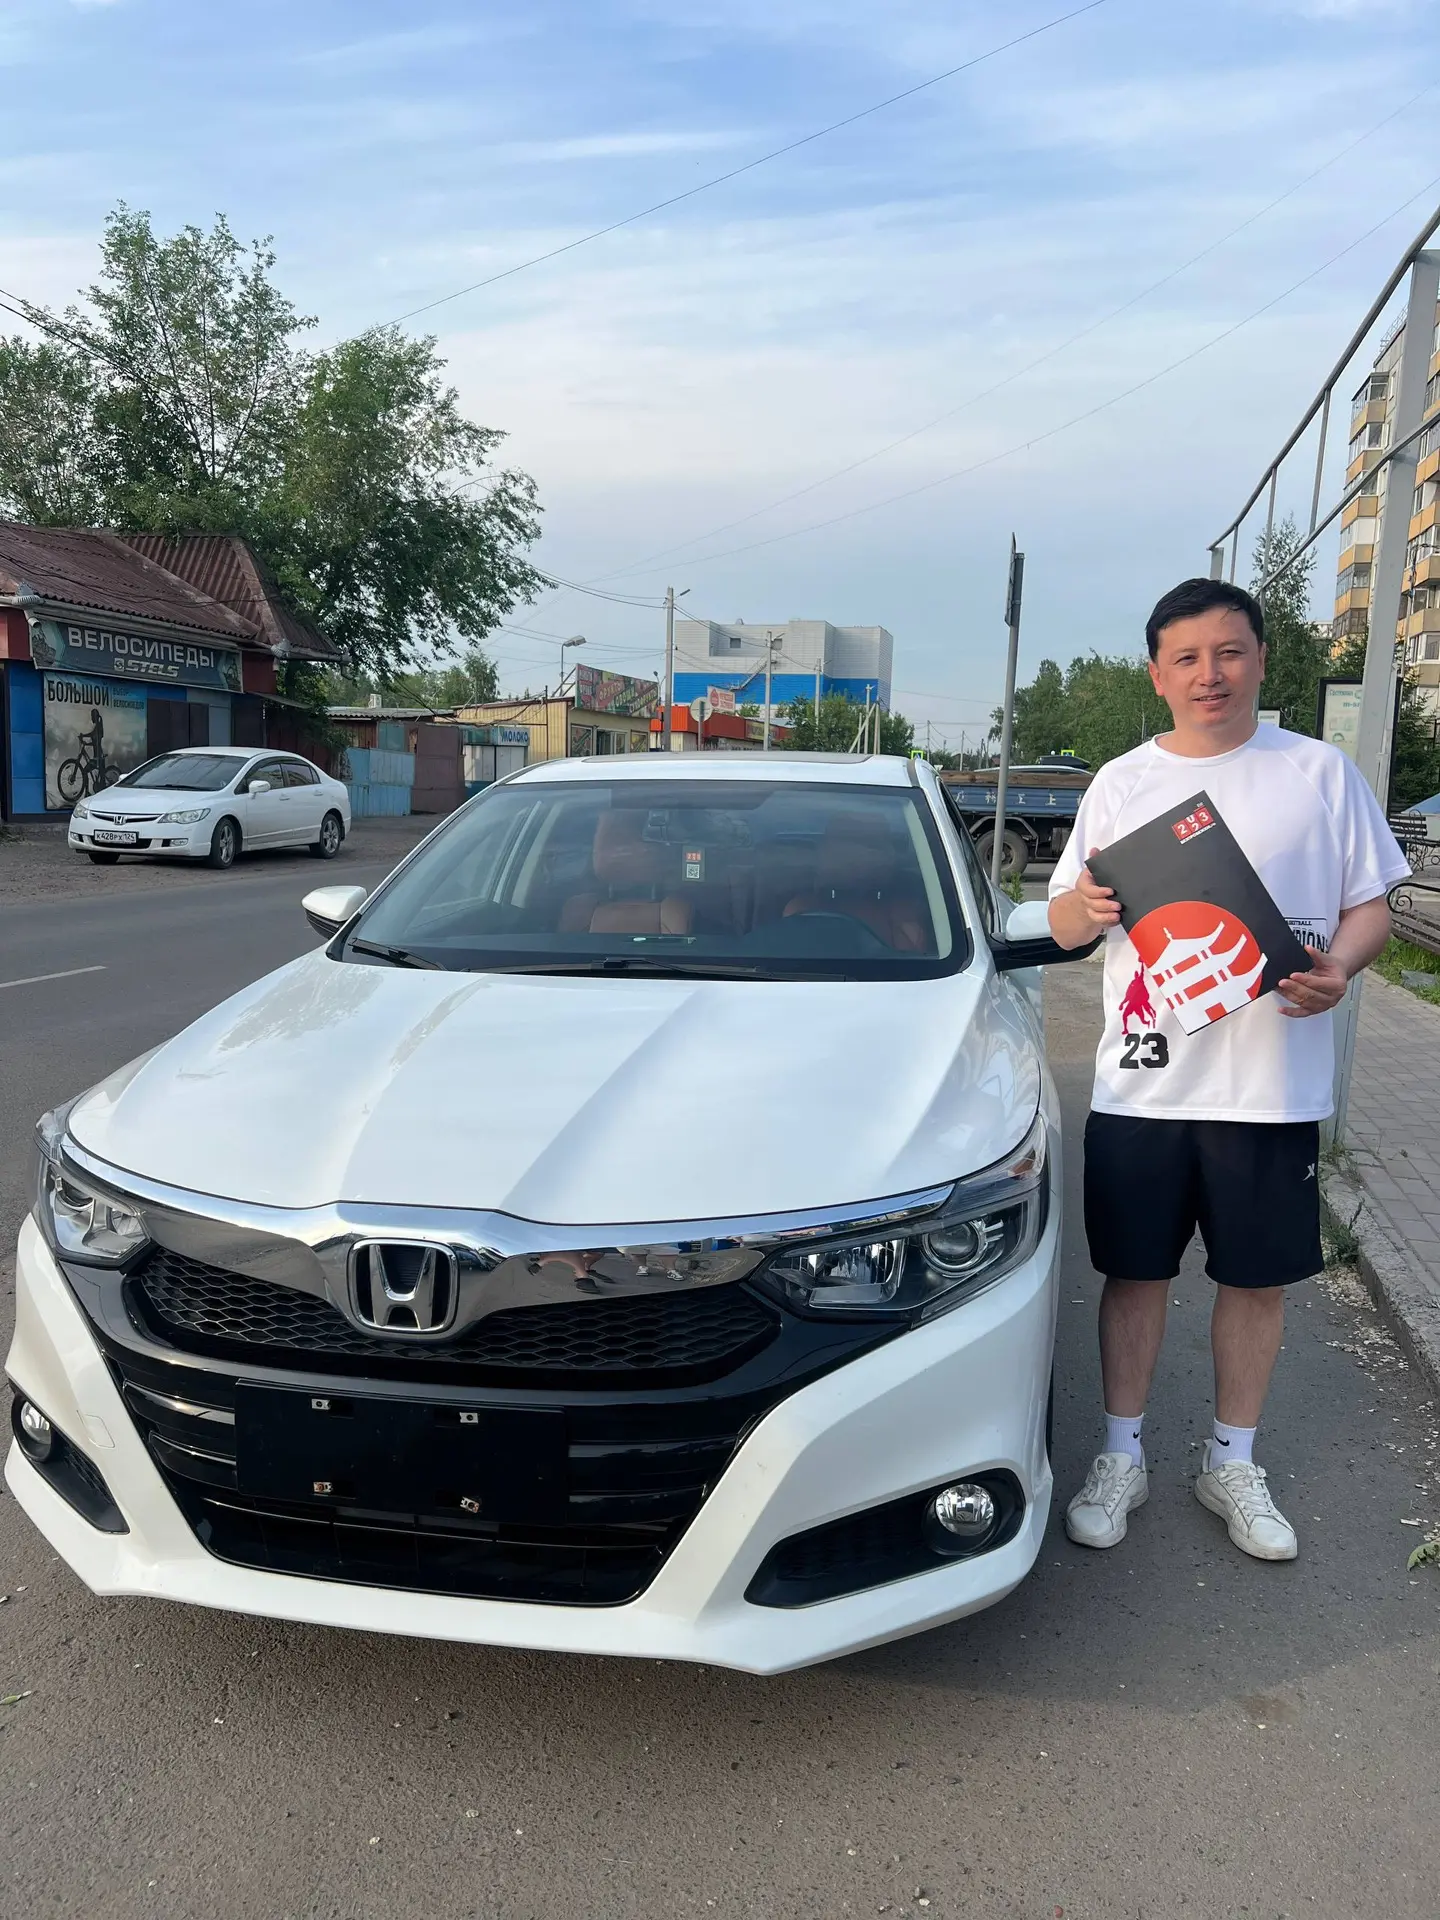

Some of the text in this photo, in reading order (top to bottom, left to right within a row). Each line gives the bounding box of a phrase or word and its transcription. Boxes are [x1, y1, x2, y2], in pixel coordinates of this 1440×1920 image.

[68, 627, 214, 669] ВЕЛОСИПЕДЫ
[124, 659, 179, 678] STELS
[48, 680, 110, 707] БОЛЬШОЙ
[502, 730, 529, 743] МОЛОКО
[1119, 1032, 1169, 1069] 23
